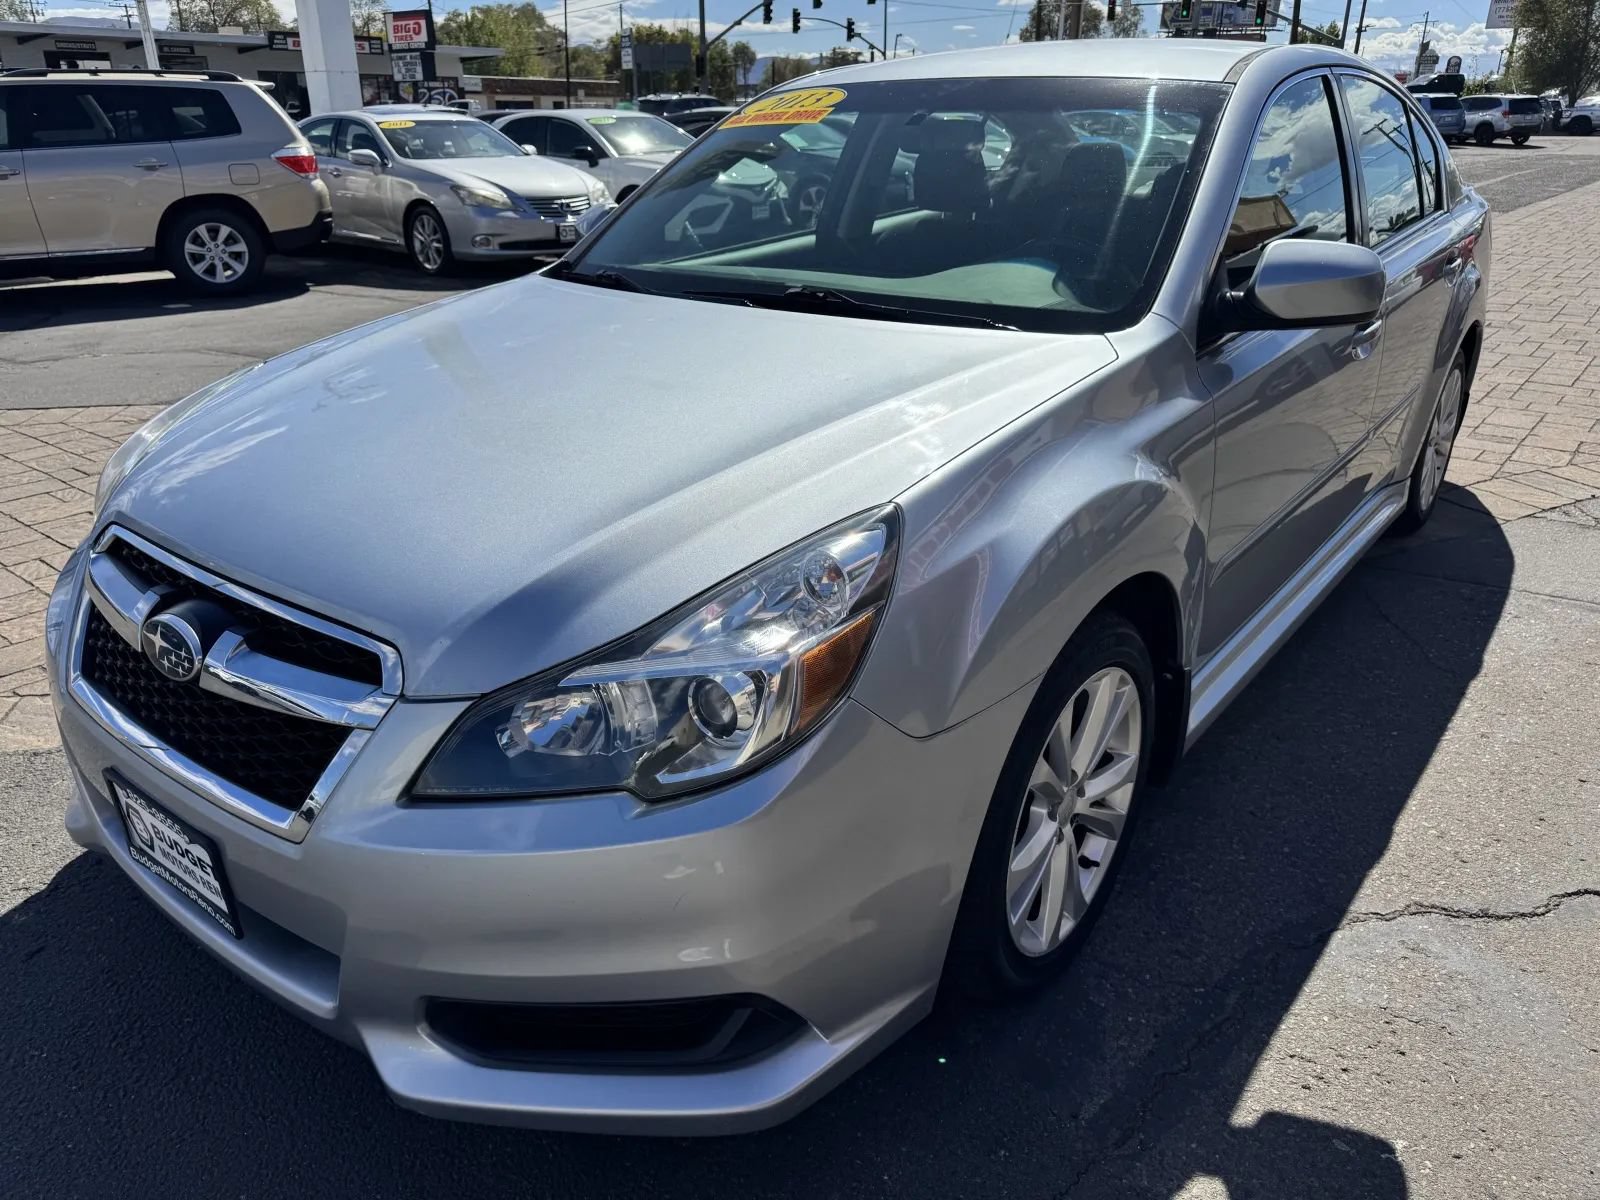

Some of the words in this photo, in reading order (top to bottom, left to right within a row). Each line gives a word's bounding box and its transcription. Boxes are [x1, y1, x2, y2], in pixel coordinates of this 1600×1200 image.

[393, 24, 411, 34] BIG
[412, 21, 422, 36] O
[393, 34, 414, 42] TIRES
[752, 91, 834, 112] 2013
[158, 844, 201, 885] MOTORS
